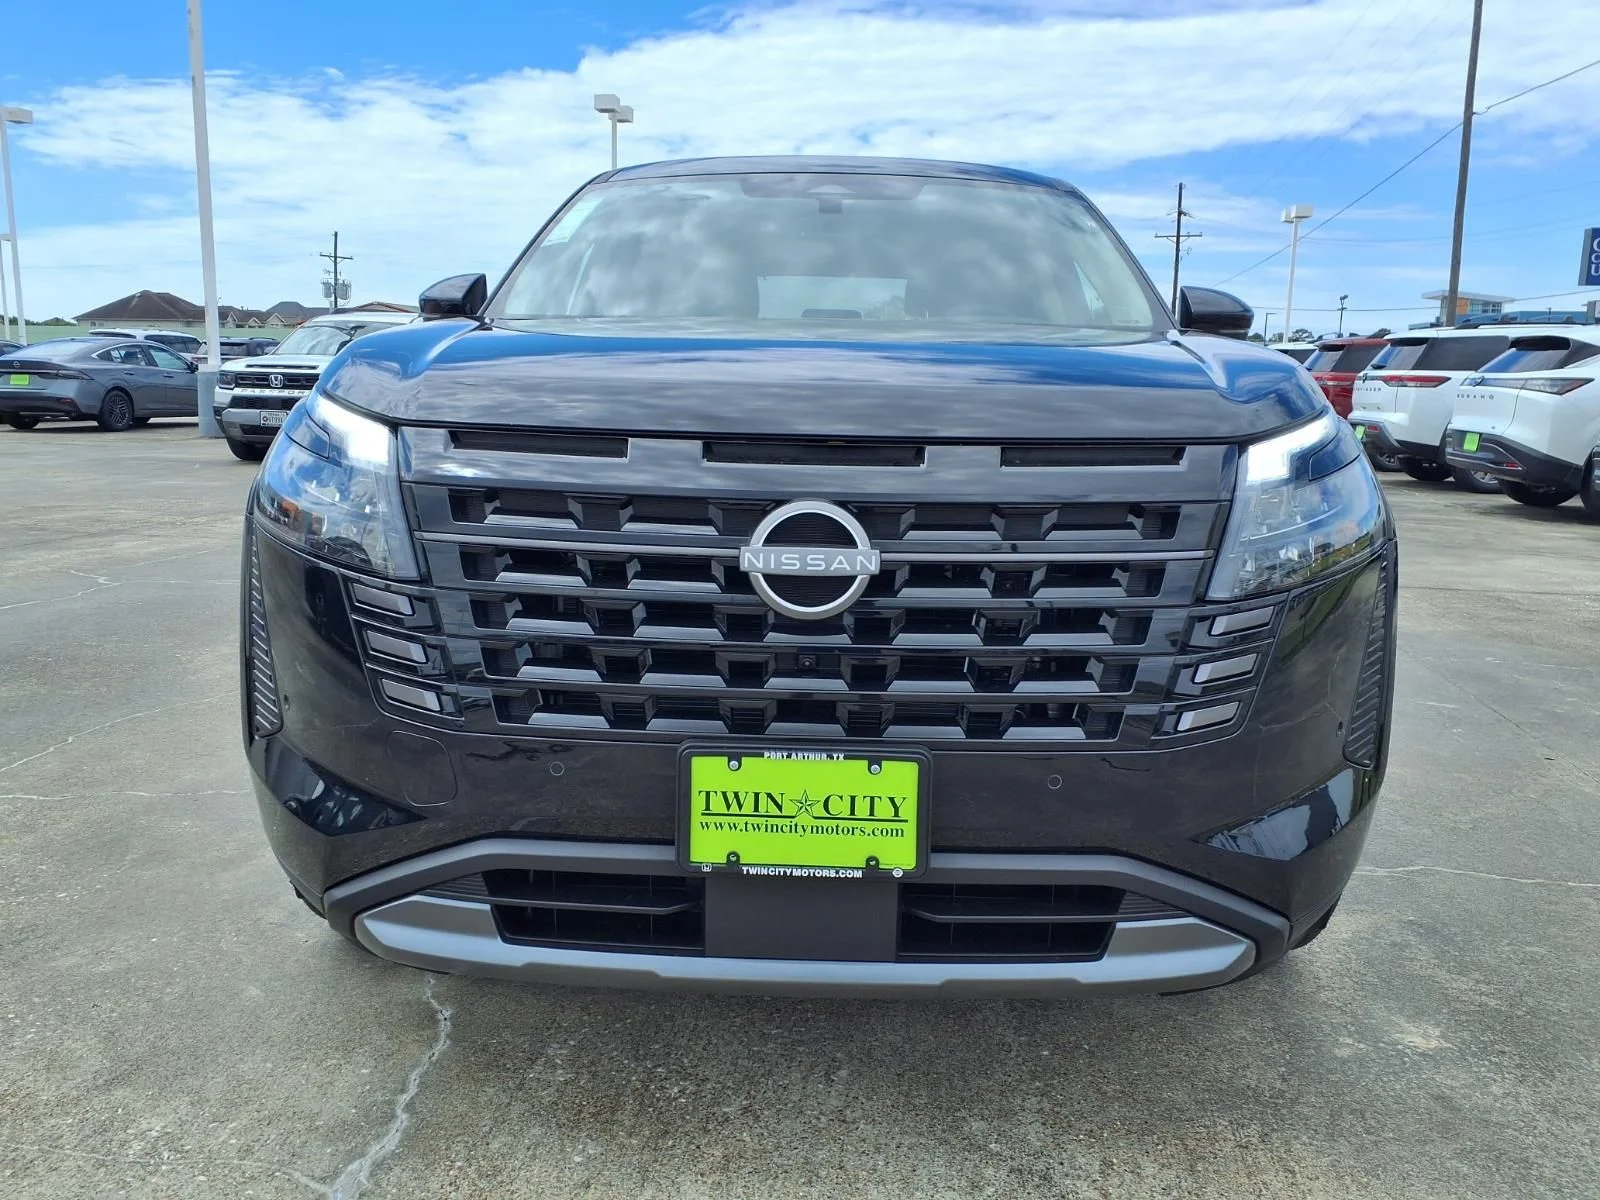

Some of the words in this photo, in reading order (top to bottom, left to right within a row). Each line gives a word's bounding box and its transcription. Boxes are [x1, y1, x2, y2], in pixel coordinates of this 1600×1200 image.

[240, 388, 310, 396] PASSPOR
[744, 551, 876, 571] NISSAN
[763, 751, 788, 760] PORT
[832, 753, 845, 761] TX
[698, 790, 786, 815] TWIN
[822, 793, 909, 818] CITY
[699, 819, 905, 838] www.twincitymotors.com
[741, 866, 863, 879] TWINCITYMOTORS.COM
